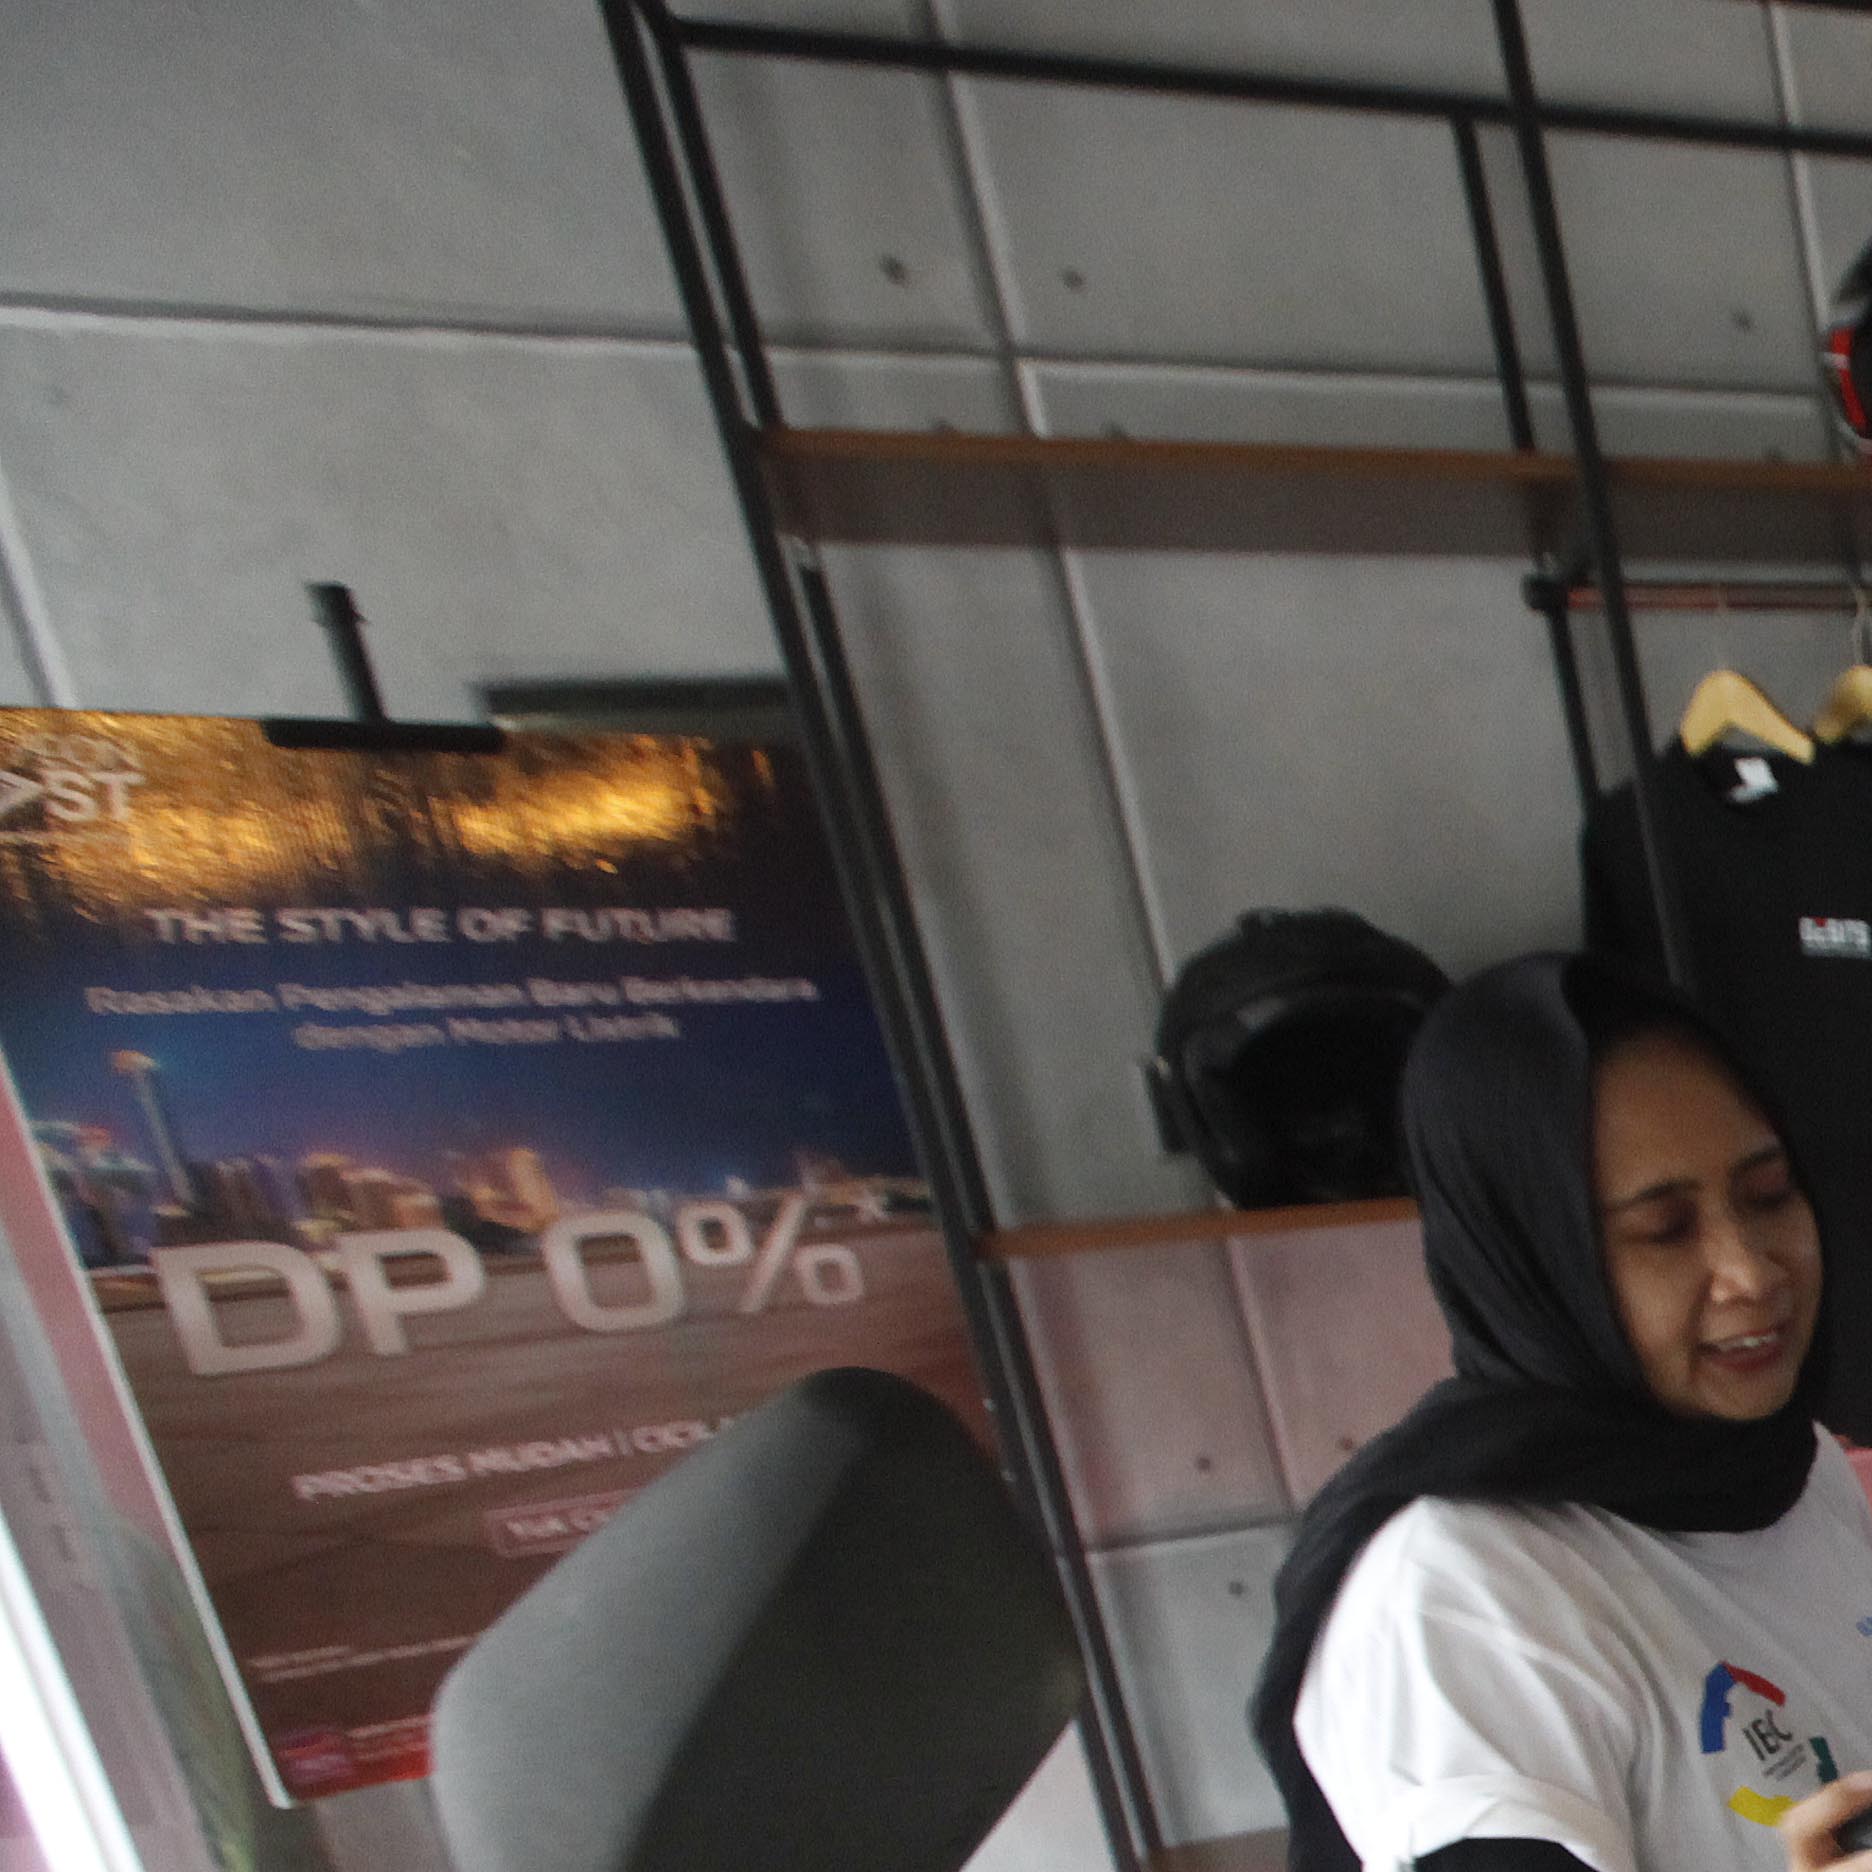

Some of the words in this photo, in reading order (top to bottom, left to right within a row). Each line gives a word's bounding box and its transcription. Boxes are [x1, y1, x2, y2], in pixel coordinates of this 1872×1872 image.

[145, 907, 268, 944] THE
[275, 907, 450, 942] STYLE
[455, 907, 532, 942] OF
[539, 907, 737, 943] FUTURE
[150, 1225, 488, 1375] DP
[543, 1199, 867, 1333] 0%
